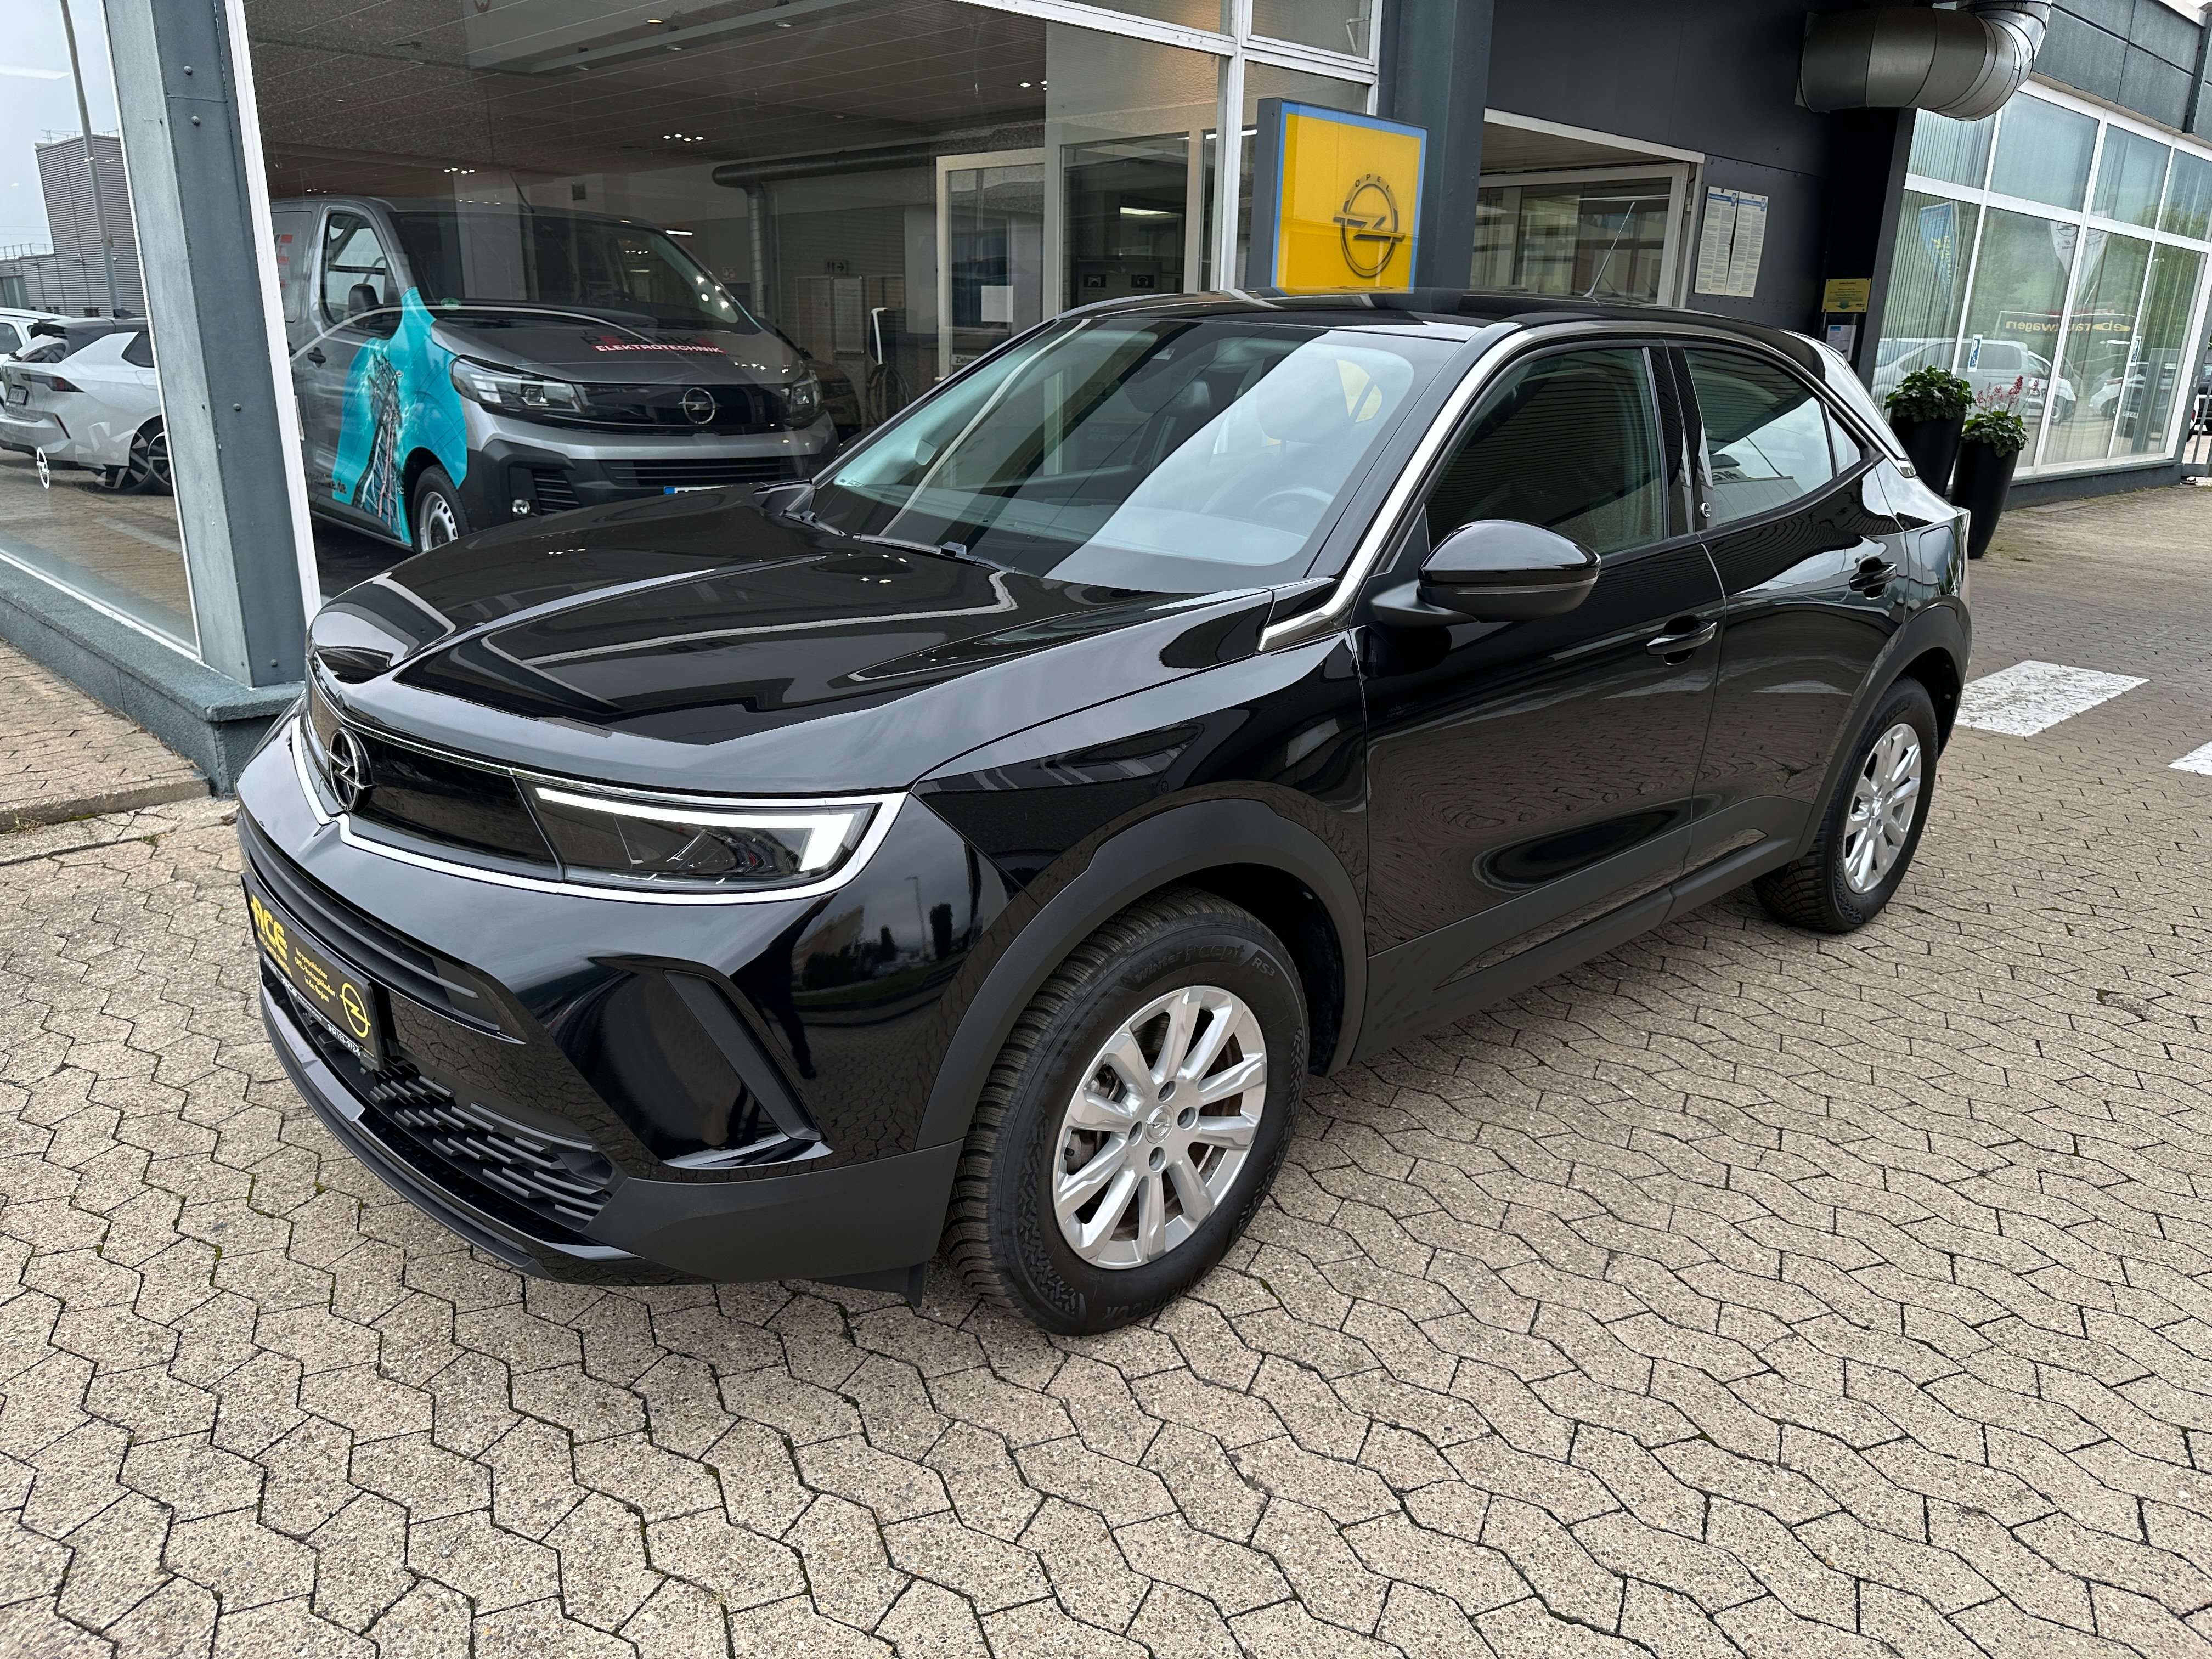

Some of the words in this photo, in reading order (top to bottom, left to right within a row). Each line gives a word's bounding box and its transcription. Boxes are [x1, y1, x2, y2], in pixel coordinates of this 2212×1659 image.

[1355, 173, 1390, 192] OPEL
[595, 344, 725, 354] ELEKTROTECHNIK
[251, 894, 288, 960] ACE
[1251, 956, 1276, 977] RS3
